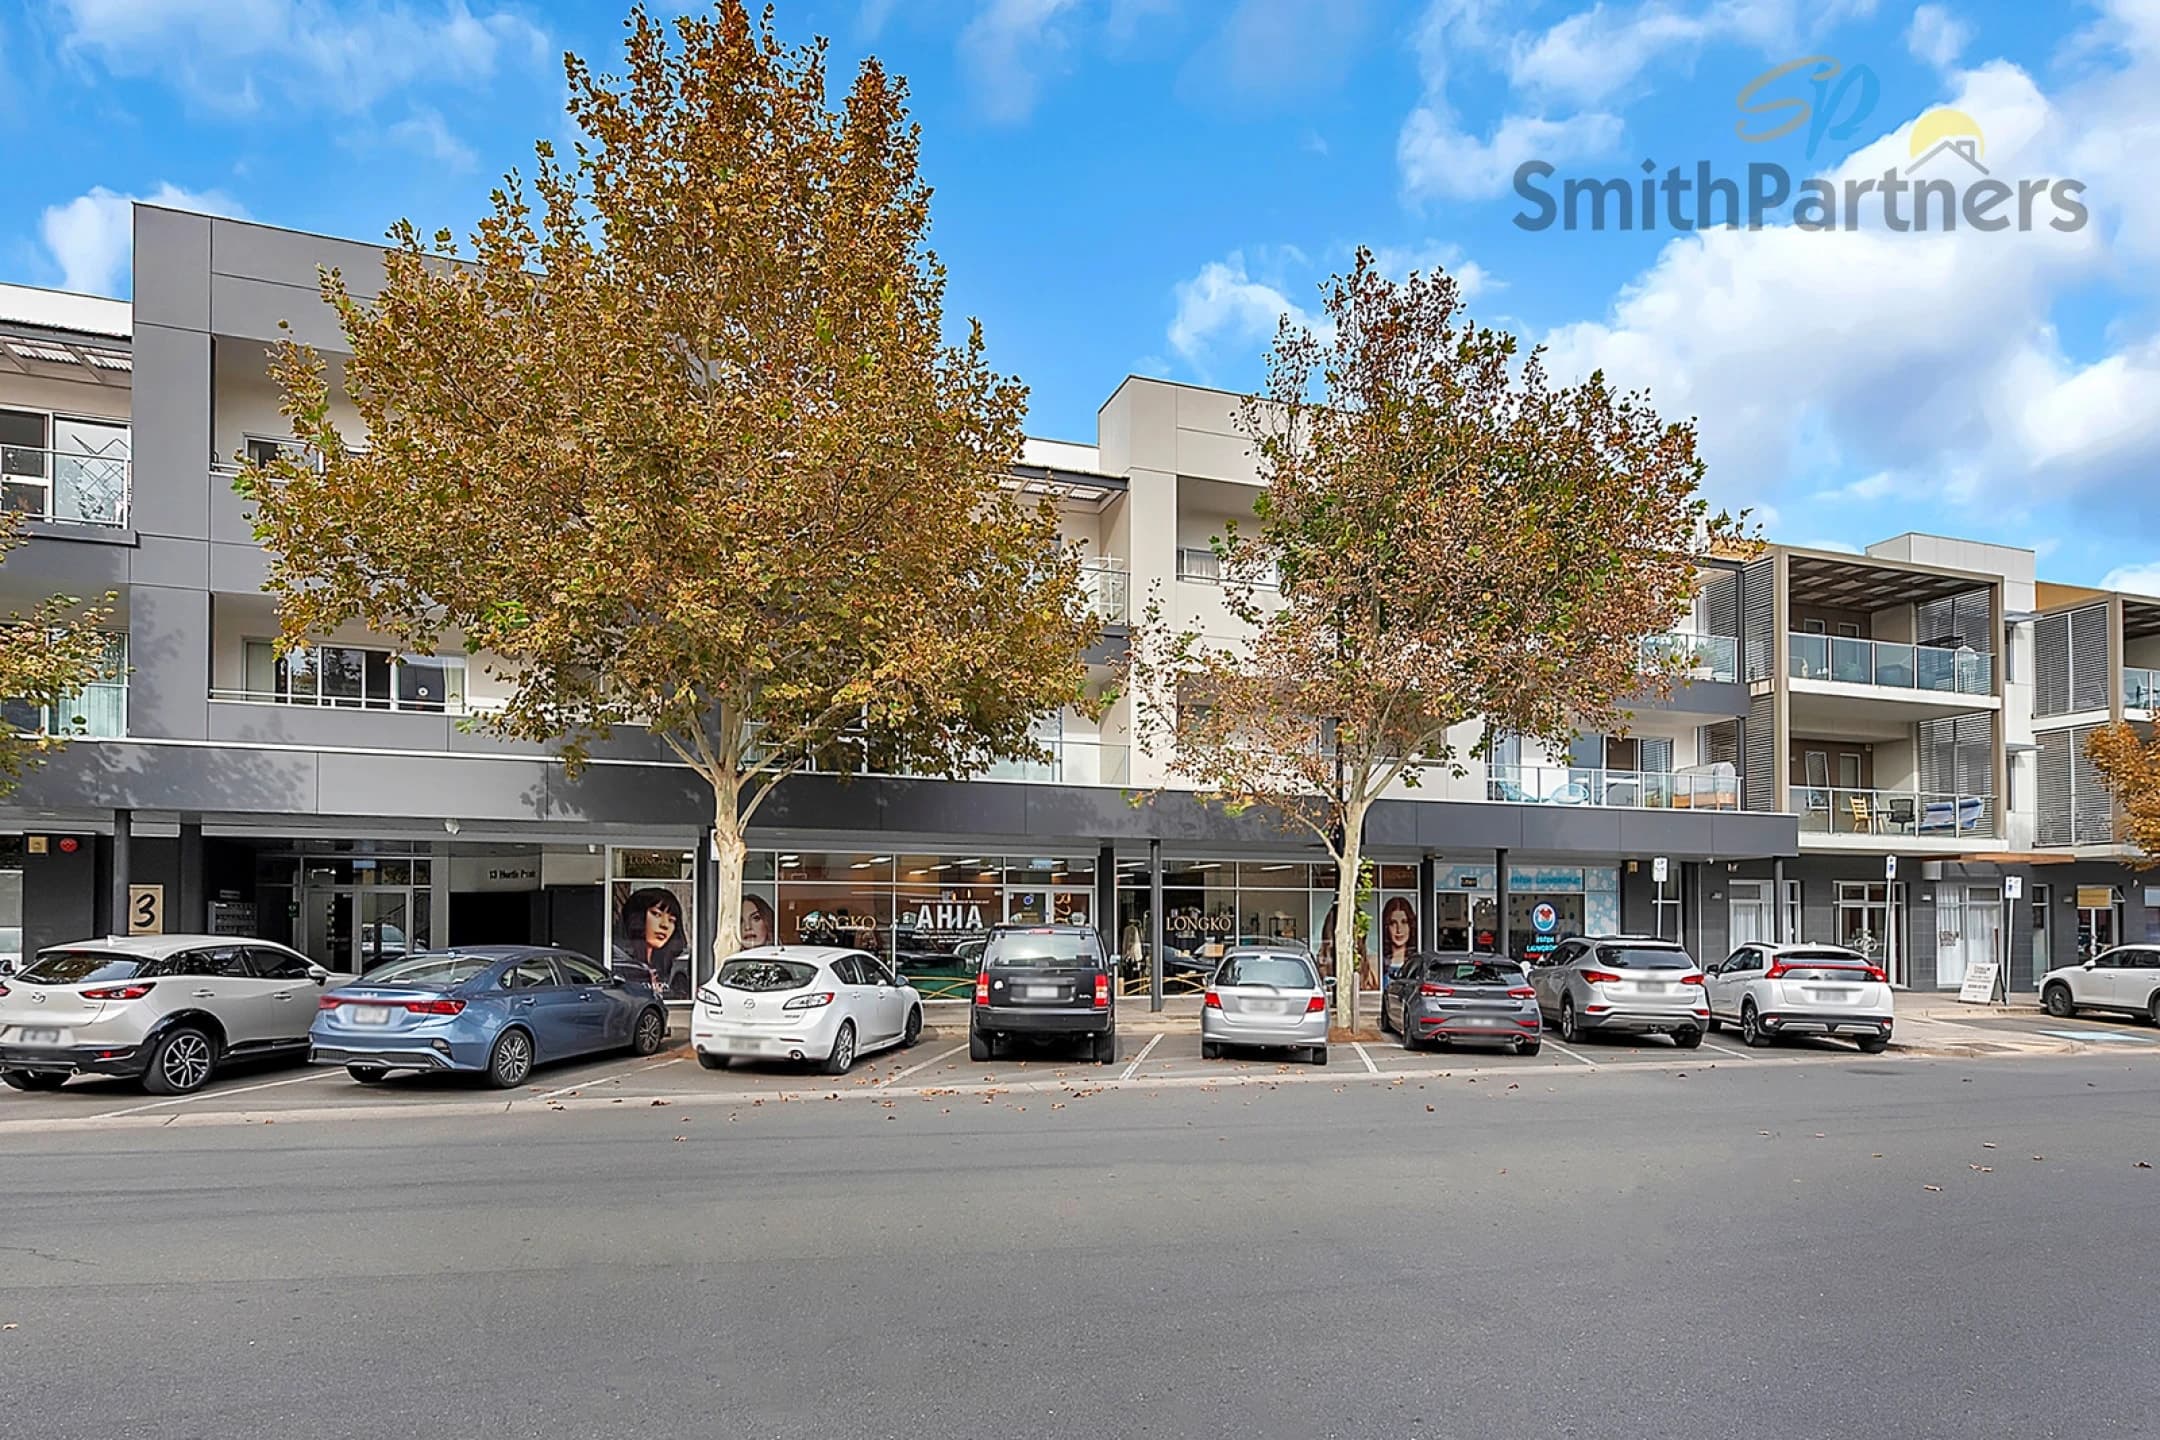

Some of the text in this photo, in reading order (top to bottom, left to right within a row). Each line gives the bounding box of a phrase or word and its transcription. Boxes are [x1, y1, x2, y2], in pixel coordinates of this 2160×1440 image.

[133, 893, 156, 928] 3
[916, 904, 984, 929] AHIA
[795, 915, 877, 931] LONGKO
[1166, 916, 1232, 931] LONGKO
